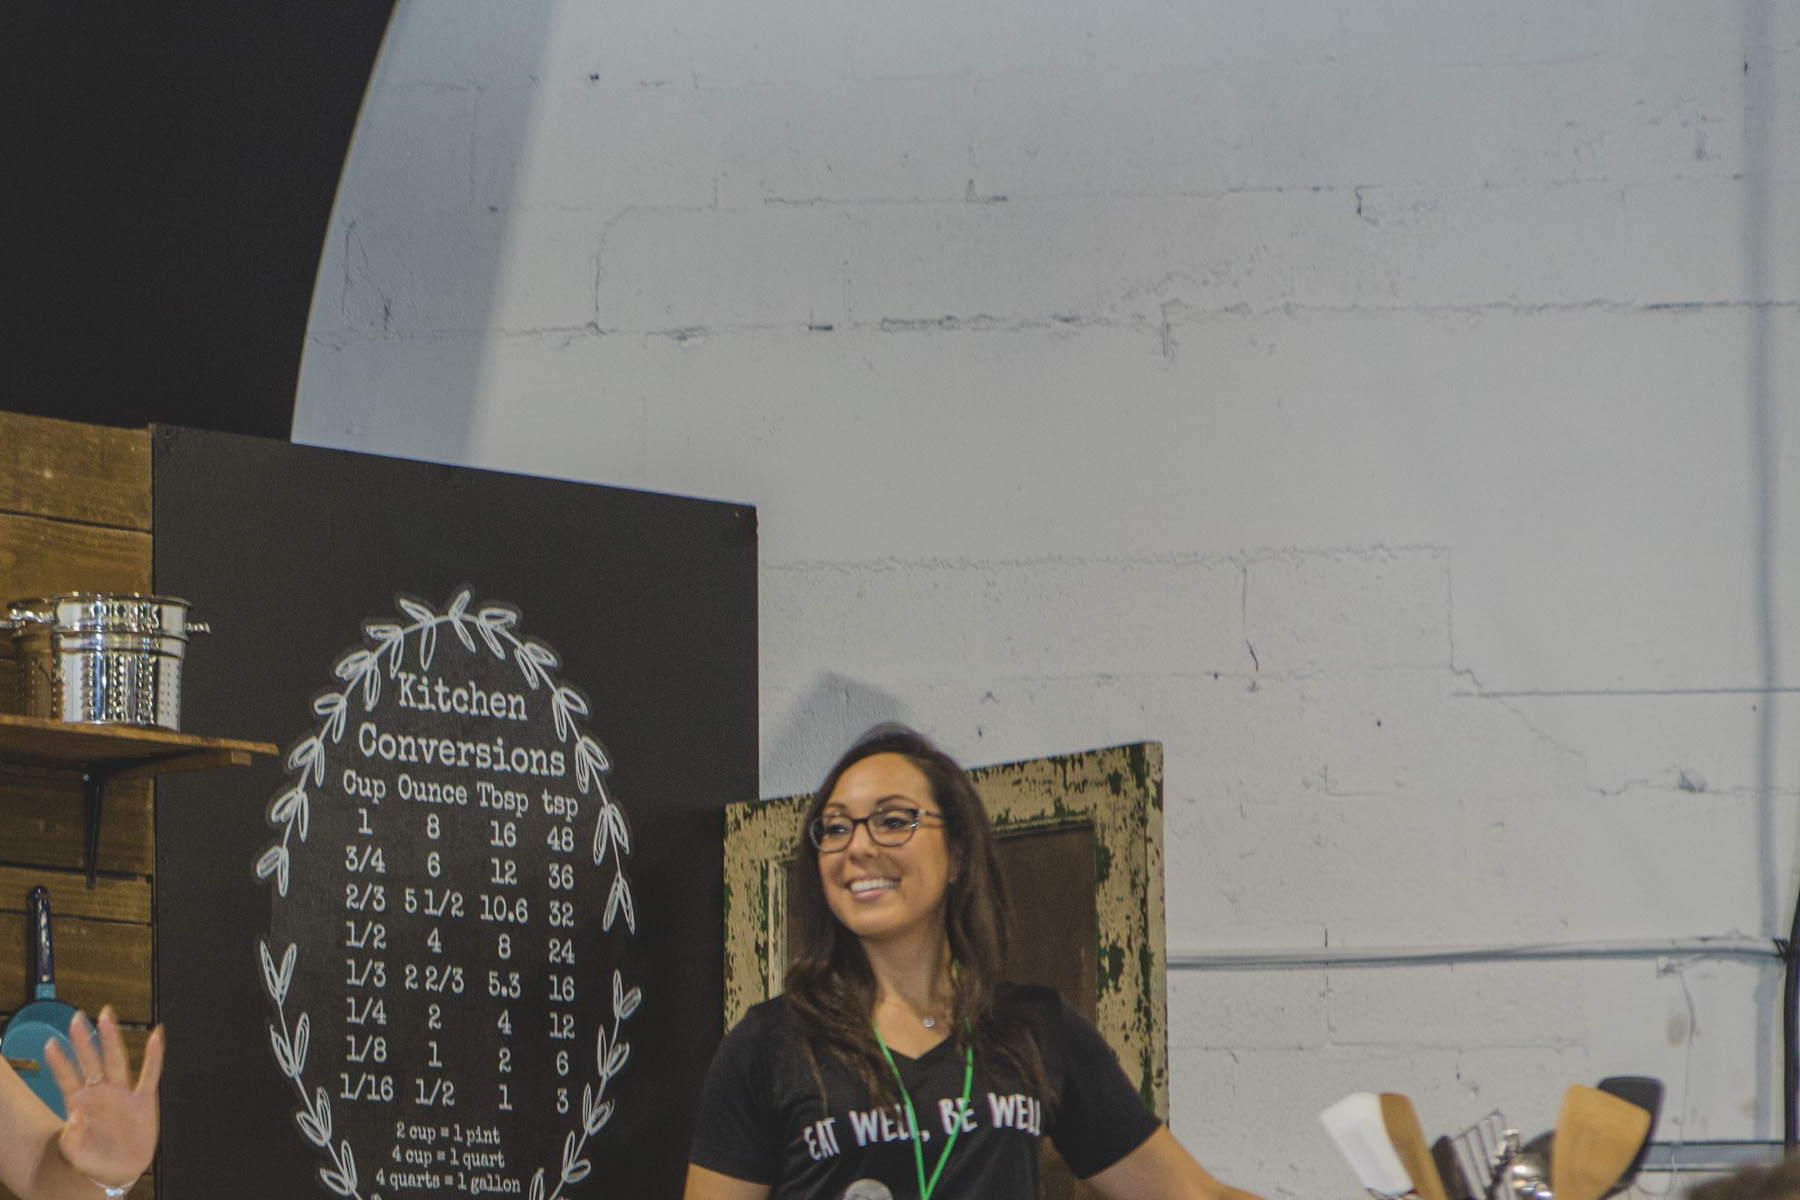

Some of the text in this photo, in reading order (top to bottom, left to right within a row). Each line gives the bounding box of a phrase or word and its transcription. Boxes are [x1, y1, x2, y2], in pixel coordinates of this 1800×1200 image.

[397, 671, 528, 721] Kitchen
[358, 721, 566, 777] Conversions
[342, 769, 579, 822] Cup Ounce Tbsp tsp
[358, 808, 574, 852] 1 8 16 48
[345, 845, 574, 890] 3/4 6 12 36
[345, 883, 574, 927] 2/3 5 1/2 10.6 32
[346, 921, 575, 964] 1/2 4 8 24
[346, 959, 575, 1002] 1/3 2 2/3 5.3 16
[346, 997, 575, 1039] 1/4 2 4 12
[346, 1035, 569, 1076] 1/8 1 2 6
[340, 1072, 569, 1114] 1/16 1/2 1 3
[396, 1121, 405, 1139] 2
[409, 1125, 436, 1144] cup
[454, 1124, 463, 1142] 1
[466, 1126, 501, 1147] pint
[803, 1117, 841, 1161] EAT
[938, 1097, 978, 1136] BE
[987, 1092, 1042, 1137] WELL
[391, 1145, 402, 1162] 4
[405, 1149, 433, 1168] cup
[450, 1148, 459, 1165] 1
[462, 1151, 505, 1170] quart
[375, 1168, 385, 1186] 4
[389, 1171, 440, 1191] quarts
[458, 1172, 467, 1190] 1
[470, 1173, 521, 1195] gallon
